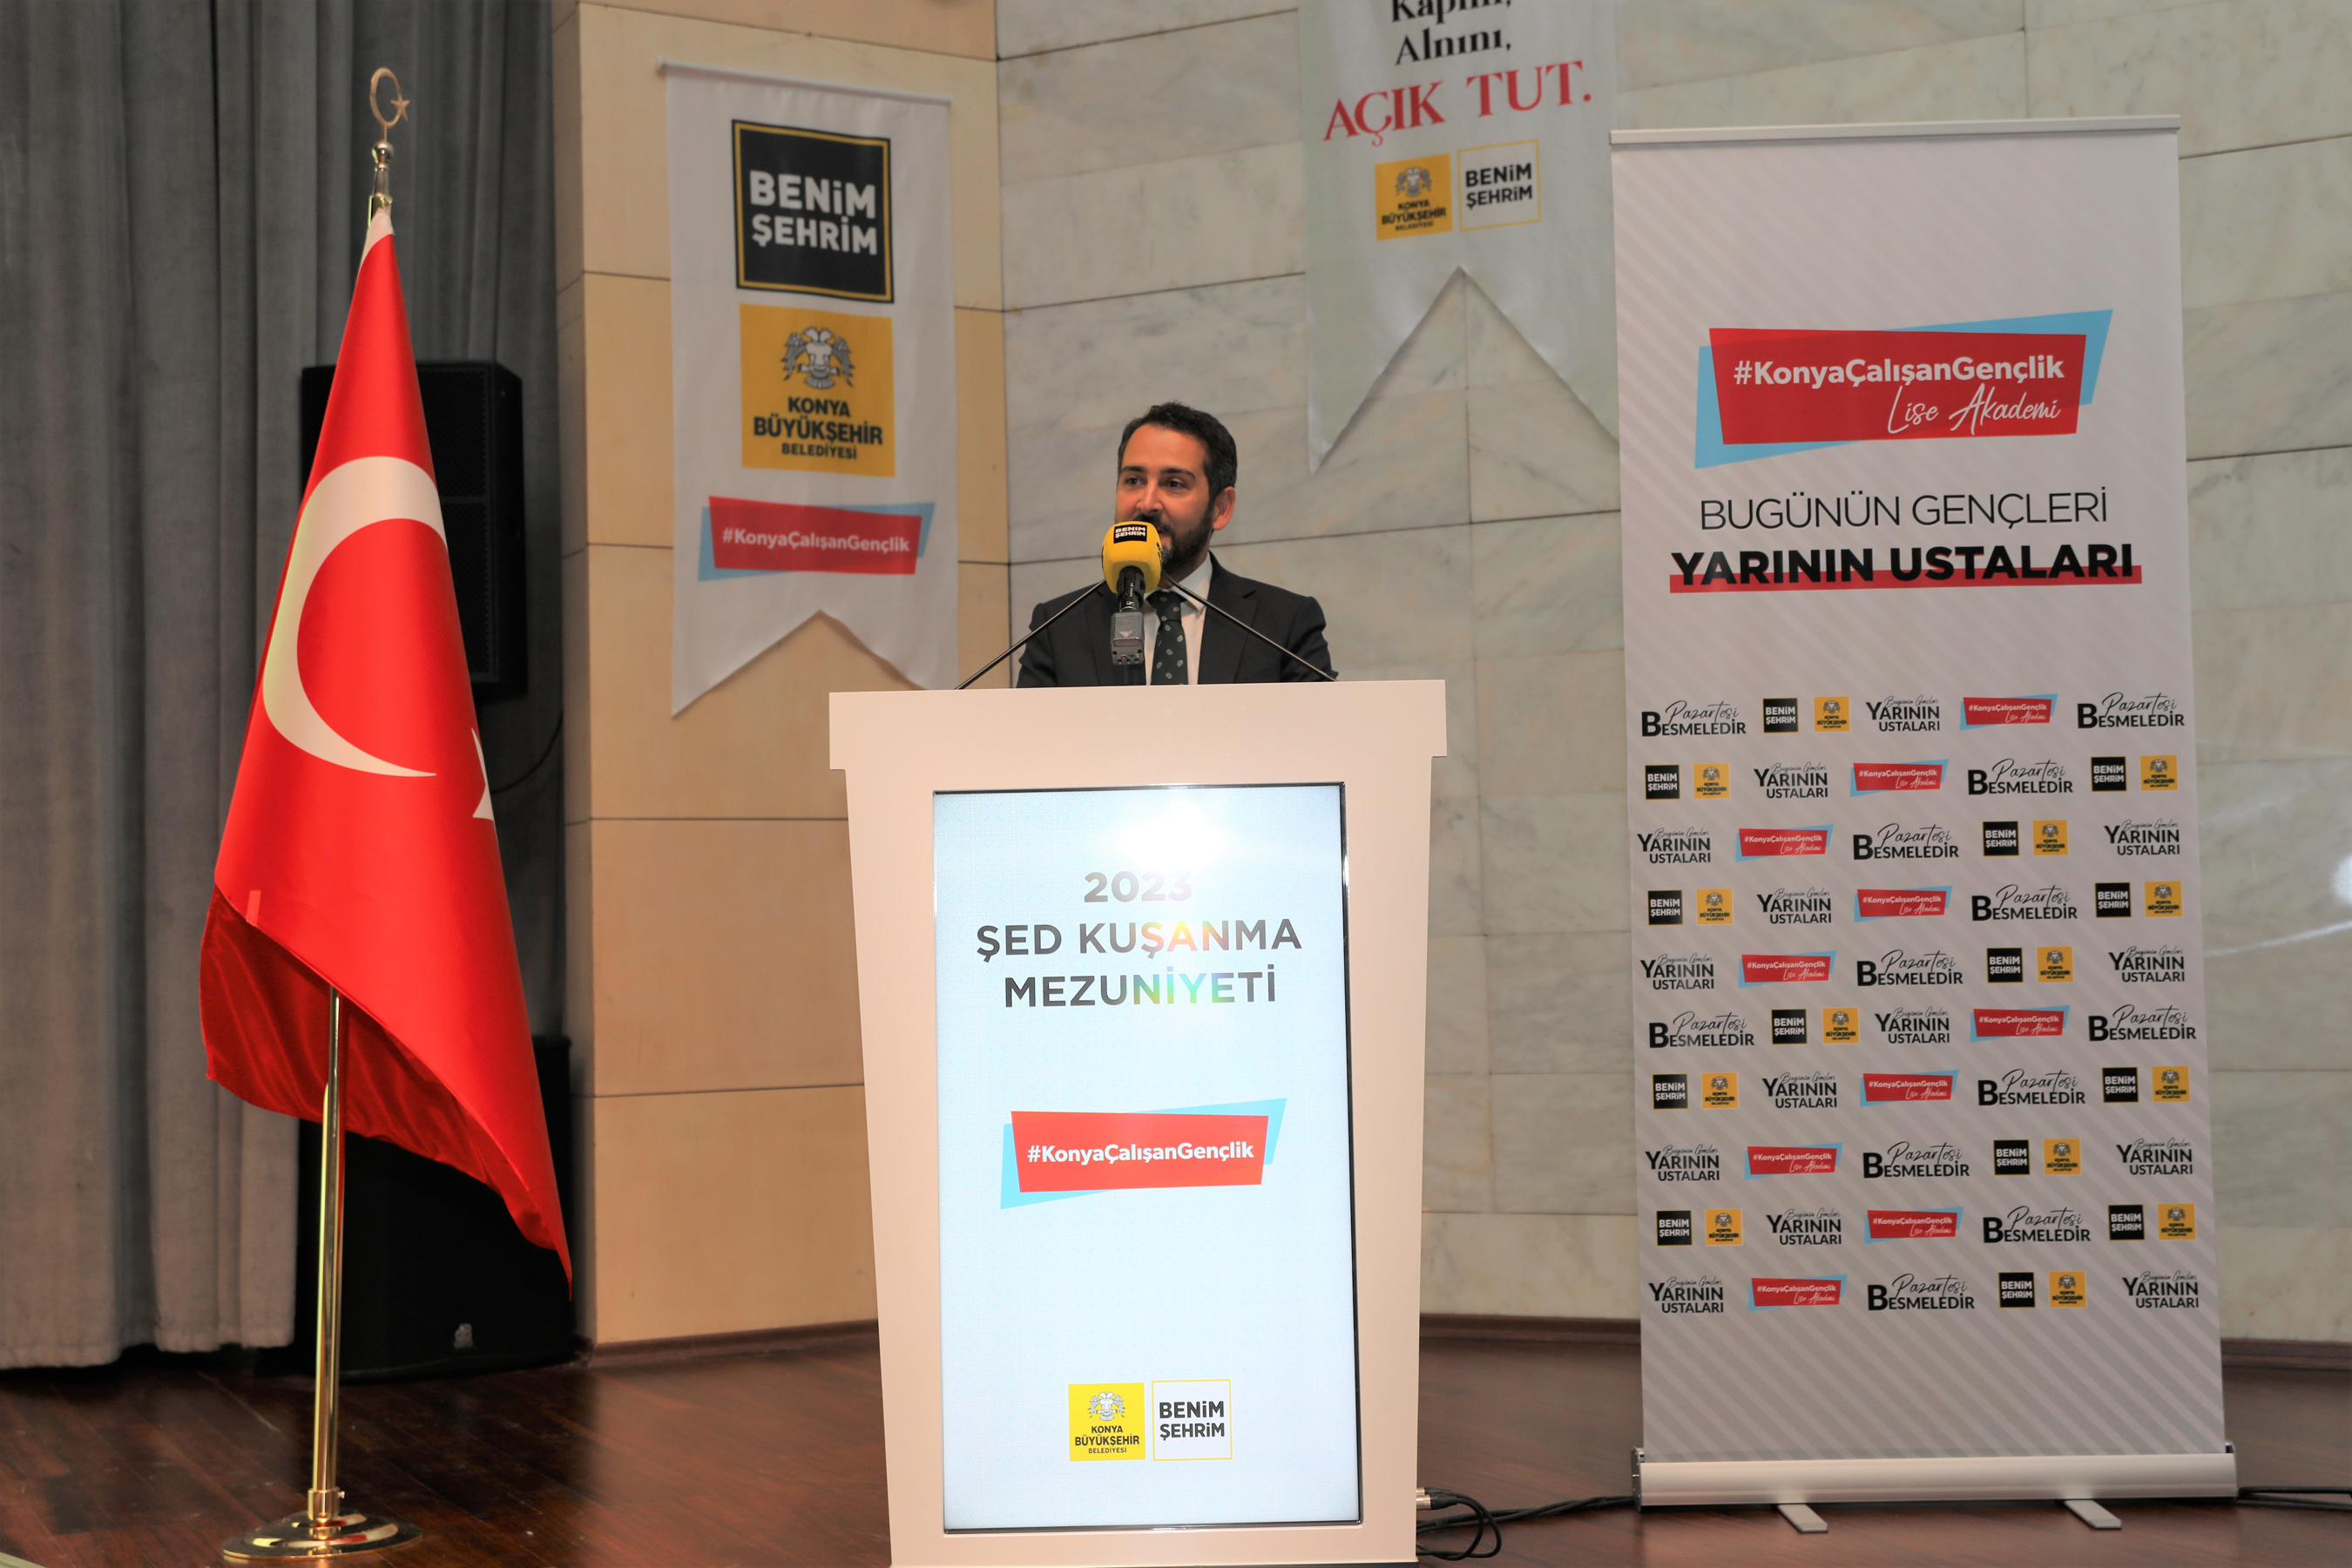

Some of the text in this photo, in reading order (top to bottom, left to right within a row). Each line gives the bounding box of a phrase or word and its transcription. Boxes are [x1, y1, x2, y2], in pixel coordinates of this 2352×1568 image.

[1395, 27, 1511, 65] Alnını,
[1322, 60, 1592, 147] AÇIK TUT.
[1398, 199, 1430, 211] KONYA
[1734, 355, 2065, 389] #KonyaÇalışanGençlik
[788, 396, 851, 417] KONYA
[1886, 383, 2061, 436] Lise Akademi
[754, 413, 882, 445] BÜYÜKŞEHİR
[781, 443, 857, 460] BELEDİYESİ
[1700, 486, 2107, 531] BUGÜNÜN GENÇLERİ
[722, 527, 909, 554] #KonyaÇalışanGençlik
[1671, 543, 2133, 586] YARININ USTALARI
[1666, 700, 1740, 724] Pazartesi
[1866, 702, 1939, 720] YARININ
[2078, 704, 2184, 730] BESMELEDİR
[2101, 693, 2177, 717] Pazartesi
[1642, 711, 1746, 737] BESMELEDİR
[1879, 720, 1939, 733] USTALARI
[1754, 768, 1828, 787] YARININ
[1968, 770, 2072, 795] BESMELEDİR
[1991, 759, 2066, 782] Pazartesi
[1767, 787, 1828, 799] USTALARI
[1638, 835, 1710, 852] YARININ
[1876, 823, 1951, 848] Pazartesi
[2104, 825, 2180, 844] YARININ
[1650, 852, 1710, 864] USTALARI
[1853, 835, 1958, 860] BESMELEDİR
[2117, 844, 2180, 856] USTALARI
[1084, 871, 1193, 902] 2023
[1995, 884, 2070, 909] Pazartesi
[1757, 895, 1831, 913] YARININ
[1971, 896, 2077, 921] BESMELEDİR
[1770, 913, 1831, 925] USTALARI
[977, 918, 1302, 963] ŞED KUŞANMA
[1640, 960, 1714, 978] YARININ
[1857, 961, 1963, 986] BESMELEDİR
[1881, 950, 1956, 974] Pazartesi
[2108, 952, 2185, 971] YARININ
[1004, 964, 1275, 1008] MEZUNİYETİ
[1653, 978, 1714, 990] USTALARI
[2121, 971, 2185, 983] USTALARI
[1673, 1011, 1747, 1036] Pazartesi
[1875, 1014, 1950, 1032] YARININ
[2112, 1004, 2189, 1029] Pazartesi
[1649, 1023, 1754, 1048] BESMELEDİR
[1888, 1032, 1950, 1044] USTALARI
[2088, 1016, 2196, 1042] BESMELEDİR
[1762, 1078, 1837, 1097] YARININ
[1977, 1080, 2085, 1106] BESMELEDİR
[2002, 1069, 2078, 1093] Pazartesi
[1775, 1097, 1837, 1109] USTALARI
[1027, 1140, 1254, 1166] #KonyaÇalışanGençlik
[1645, 1152, 1720, 1170] YARININ
[1887, 1141, 1963, 1166] Pazartesi
[2116, 1145, 2193, 1164] YARININ
[1658, 1170, 1720, 1182] USTALARI
[1863, 1152, 1970, 1179] BESMELEDİR
[2129, 1164, 2193, 1176] USTALARI
[1766, 1214, 1842, 1233] YARININ
[1983, 1217, 2091, 1243] BESMELEDİR
[2007, 1206, 2084, 1230] Pazartesi
[1779, 1233, 1842, 1246] USTALARI
[1648, 1284, 1723, 1302] YARININ
[1868, 1285, 1975, 1311] BESMELEDİR
[1892, 1274, 1968, 1298] Pazartesi
[2121, 1277, 2199, 1297] YARININ
[1661, 1302, 1723, 1315] USTALARI
[2135, 1297, 2199, 1309] USTALARI
[1075, 1434, 1139, 1447] BÜYÜKŞEHİR
[1092, 1425, 1123, 1434] KONYA
